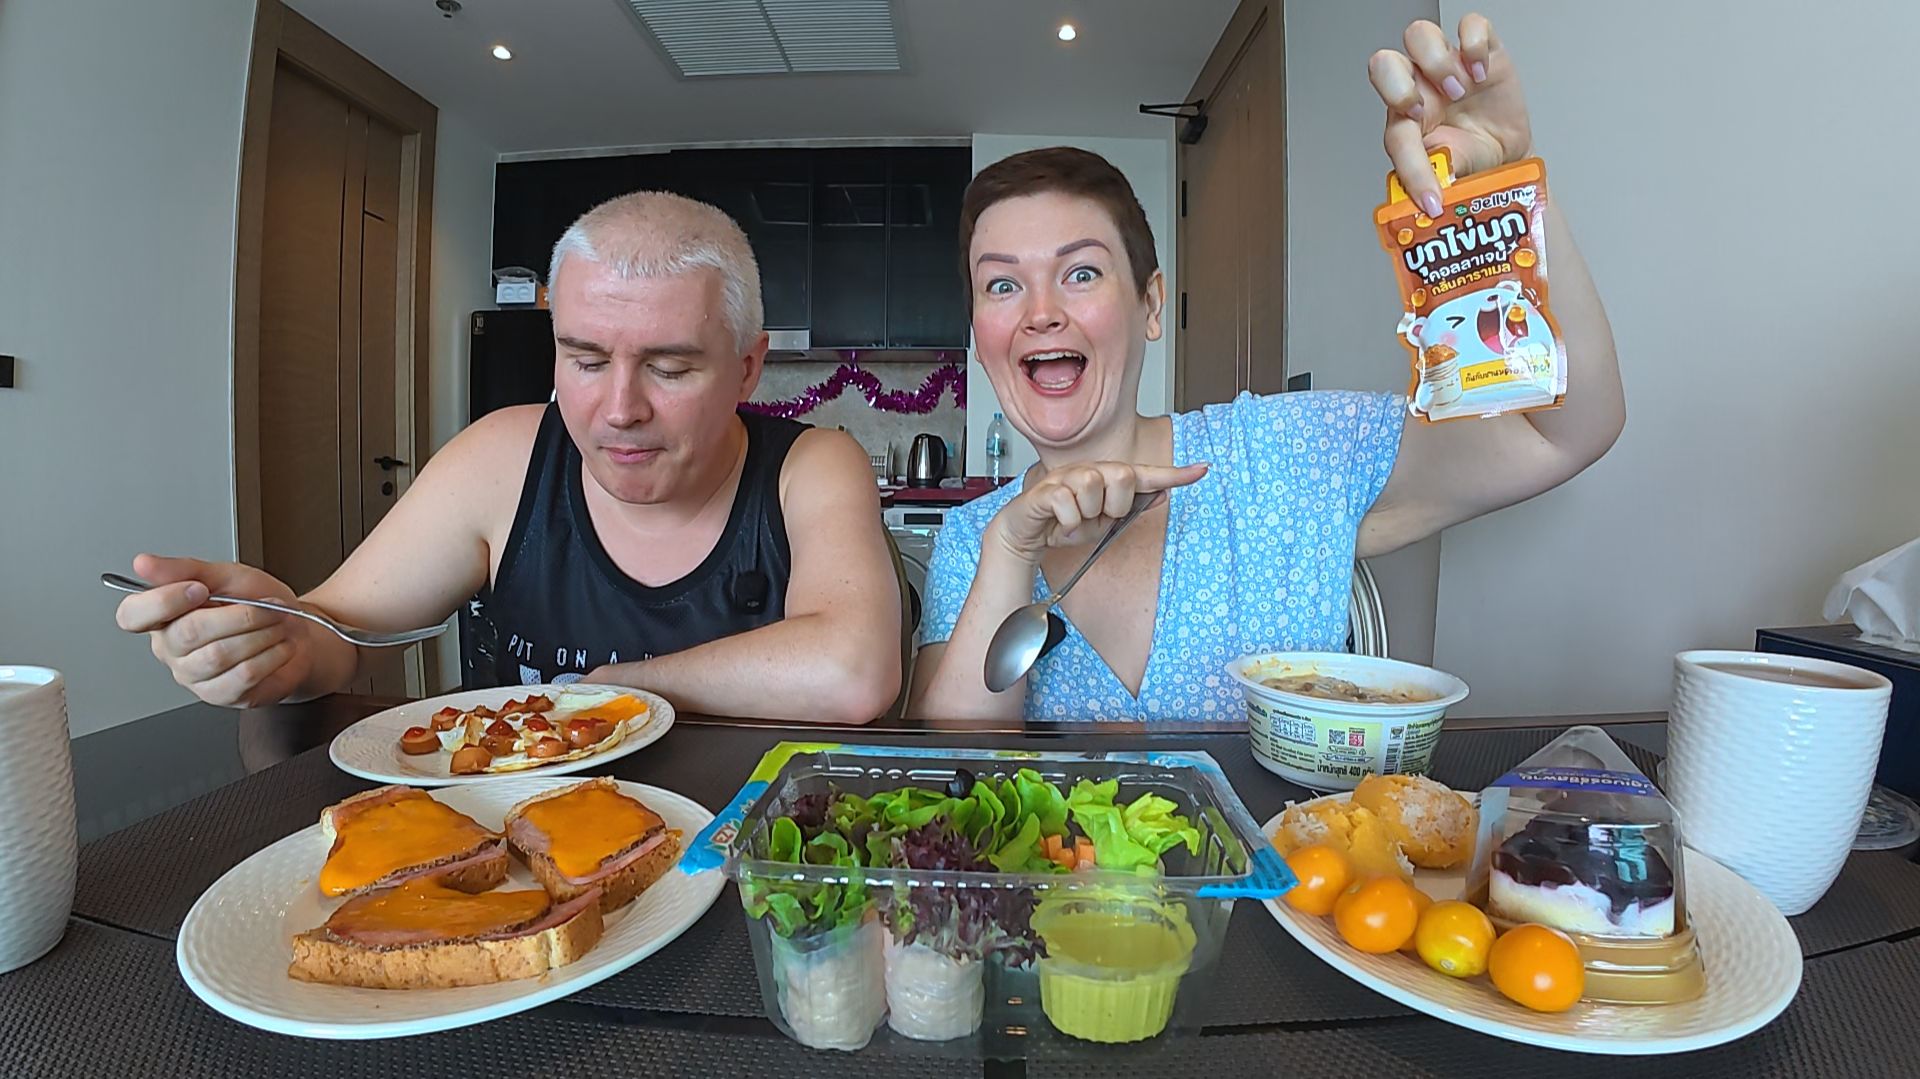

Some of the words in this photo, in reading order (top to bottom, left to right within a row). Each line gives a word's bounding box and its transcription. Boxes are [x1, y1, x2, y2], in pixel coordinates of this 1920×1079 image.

[1472, 191, 1509, 213] Jelly
[1405, 211, 1526, 277] บุกไข่มุก
[508, 634, 534, 661] PUT
[557, 647, 587, 669] ON
[610, 651, 618, 665] A
